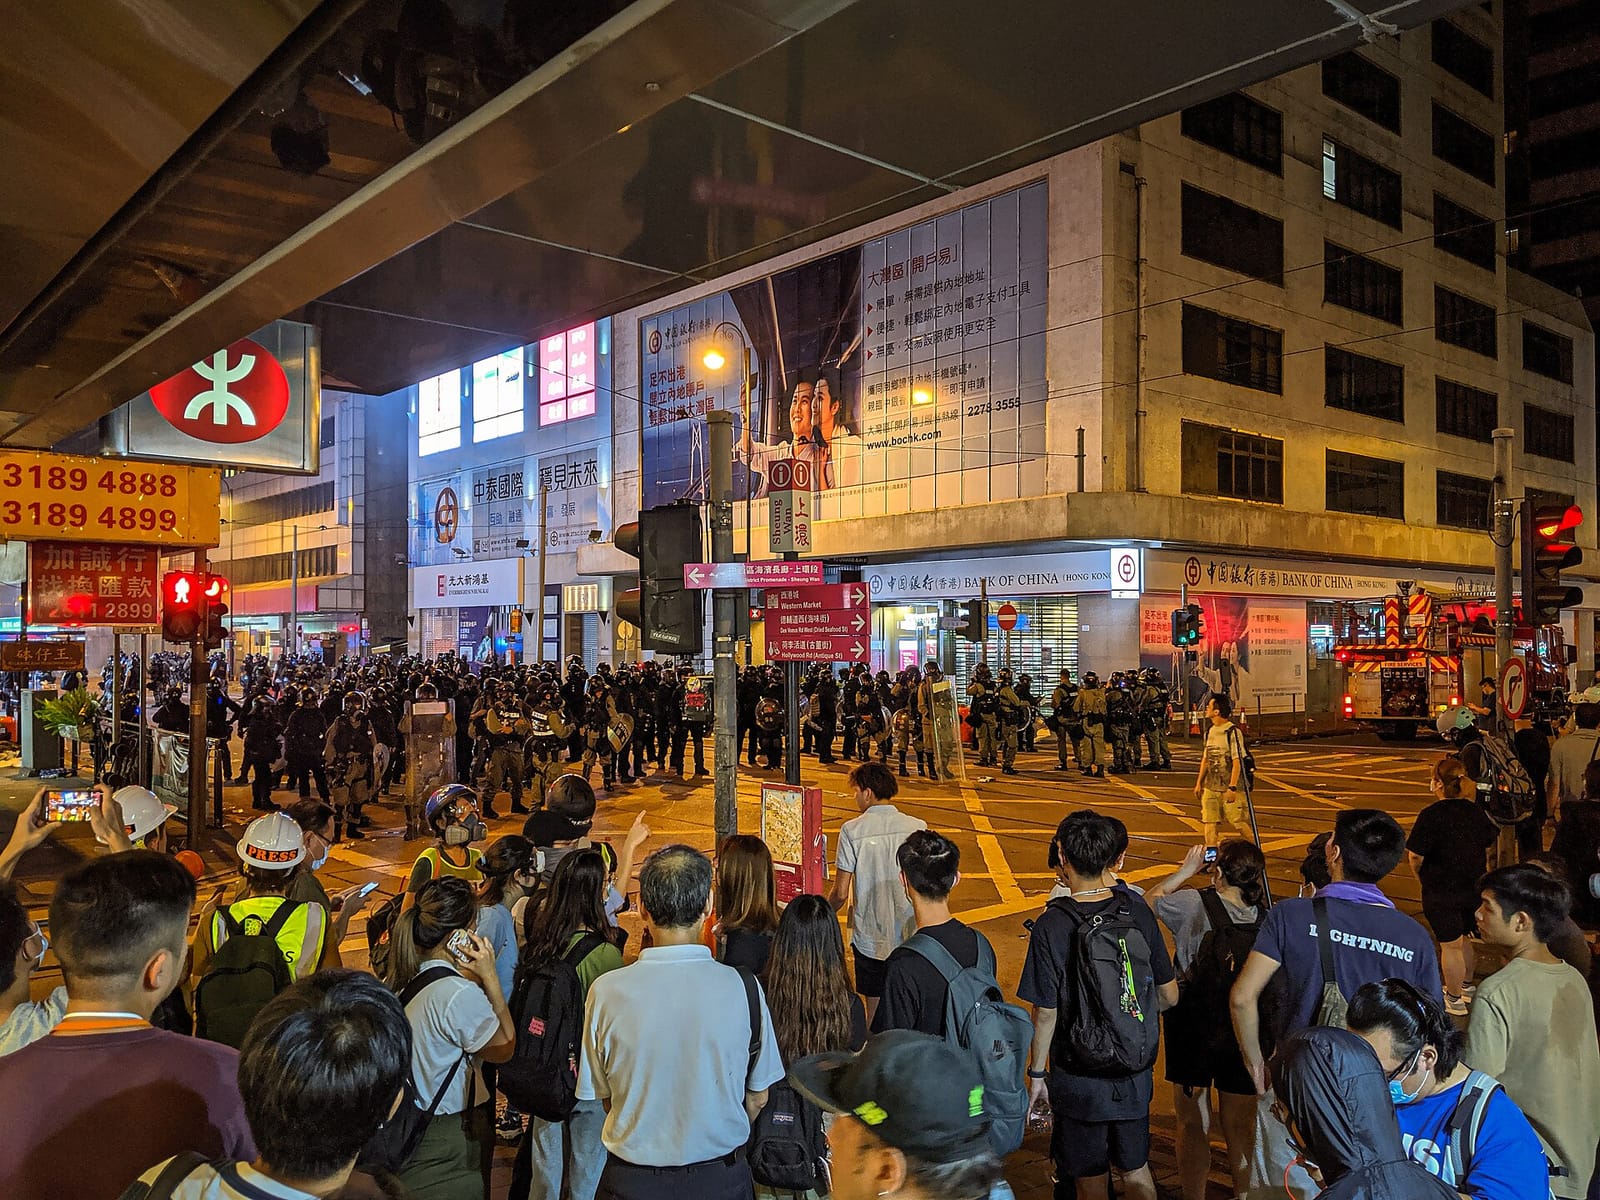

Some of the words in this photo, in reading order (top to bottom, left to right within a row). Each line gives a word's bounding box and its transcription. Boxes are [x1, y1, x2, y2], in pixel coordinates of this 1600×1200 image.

[649, 365, 686, 388] 足不出港
[967, 402, 992, 417] 2278
[995, 397, 1021, 412] 3555
[866, 429, 942, 450] www.bochk.com
[3, 463, 88, 492] 3189
[97, 470, 177, 497] 4888
[473, 471, 524, 503] 中泰國際
[2, 500, 88, 528] 3189
[97, 506, 177, 532] 4899
[772, 498, 783, 545] Sheung
[783, 508, 792, 535] Wan
[795, 496, 810, 546] 上環
[43, 546, 147, 572] 加誠行
[744, 565, 819, 575] 區海濱長廊-上環段
[37, 574, 153, 598] 找換匯款
[998, 574, 1014, 587] OF
[1017, 573, 1059, 585] CHINA
[1062, 573, 1089, 582] (HONG
[1282, 573, 1309, 587] BANK
[1310, 574, 1322, 588] OF
[1324, 575, 1353, 589] CHINA
[105, 603, 152, 618] 2899
[780, 602, 802, 611] Western
[803, 601, 821, 609] Market
[781, 640, 832, 650] 荷李活道(古董街)
[781, 651, 806, 659] Hollywood
[813, 651, 834, 660] (Antique
[834, 651, 843, 660] St)
[247, 845, 297, 862] PRESS
[1308, 923, 1415, 963] LGHTNING
